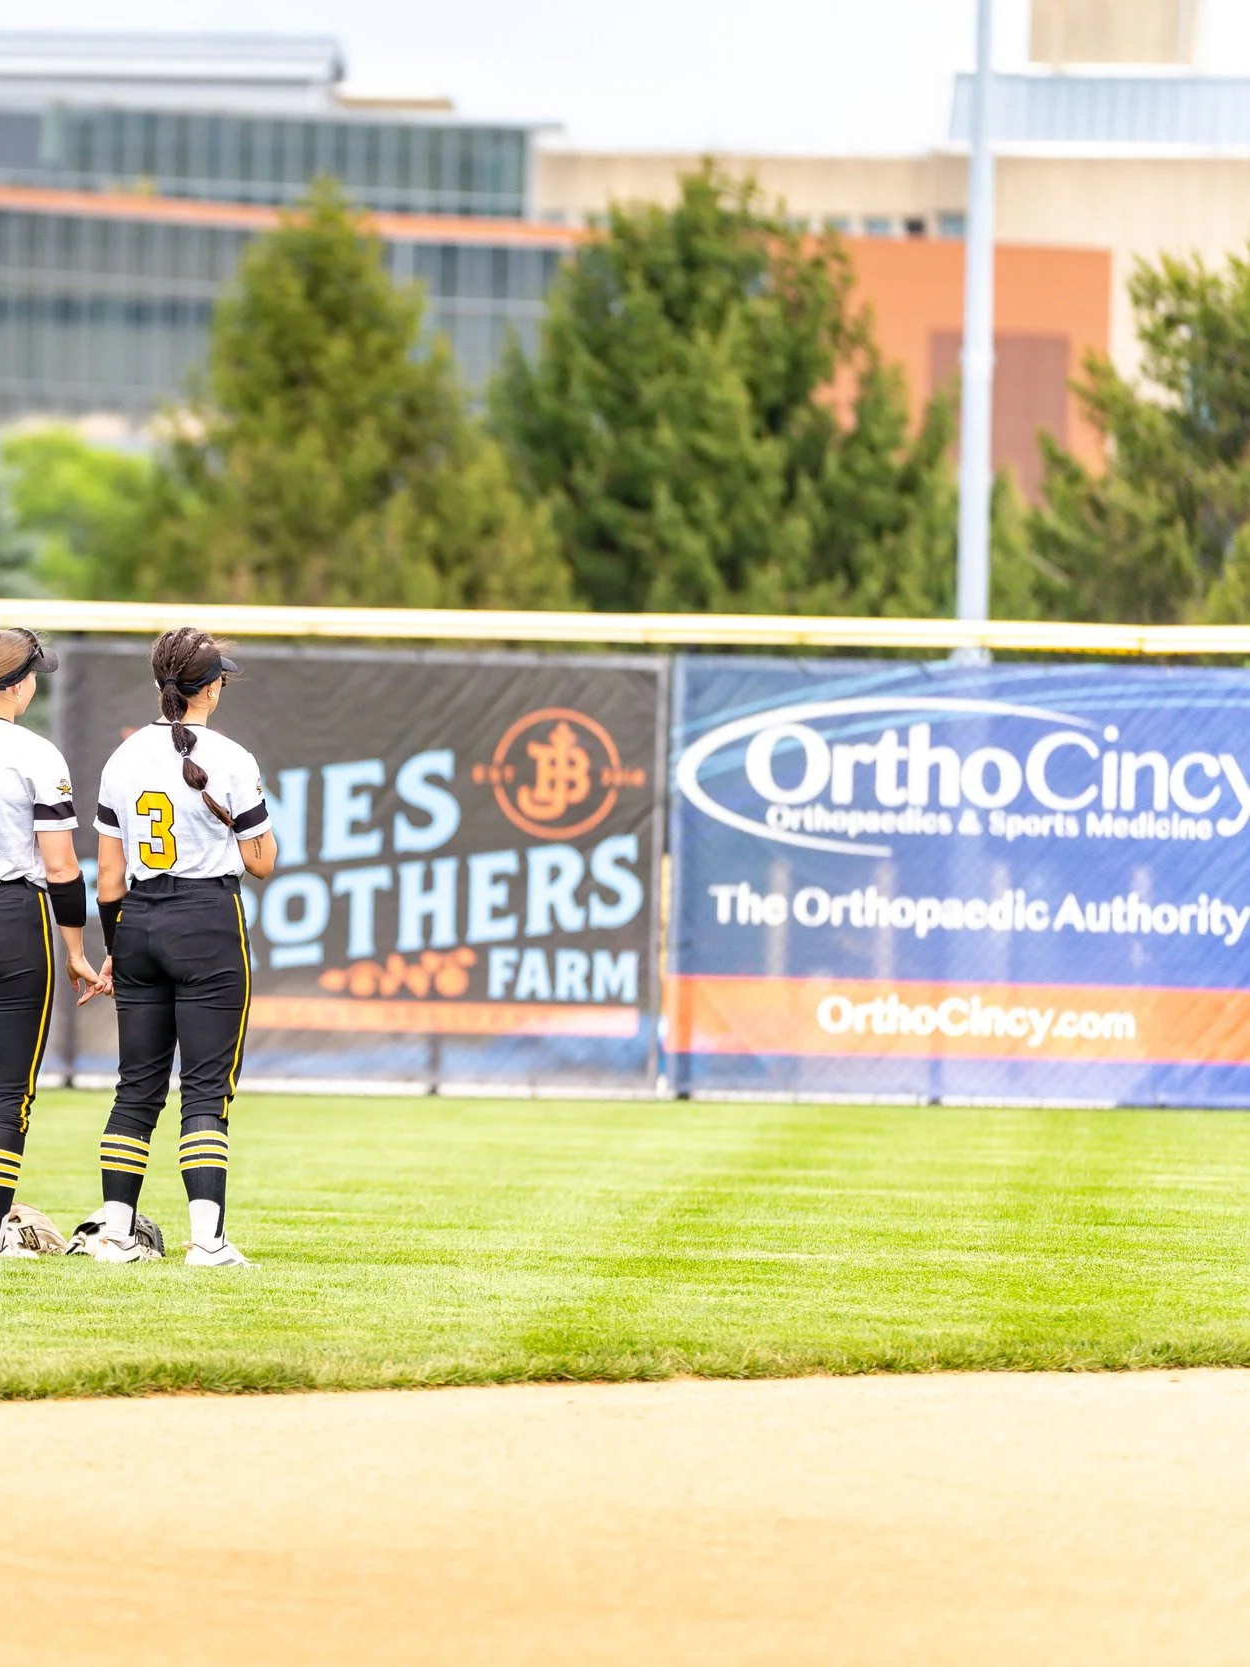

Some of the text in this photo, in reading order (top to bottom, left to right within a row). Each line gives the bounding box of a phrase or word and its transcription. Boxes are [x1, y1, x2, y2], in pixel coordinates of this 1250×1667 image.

[263, 750, 461, 869] NES
[745, 723, 1250, 838] OrthoCincy
[136, 790, 177, 869] 3
[766, 803, 953, 838] Orthopaedics
[988, 808, 1080, 841] Sports
[1086, 811, 1213, 841] Medicine
[240, 834, 643, 969] OTHERS
[709, 883, 1250, 946] The Orthopaedic Authority
[487, 947, 639, 1002] FARM
[817, 995, 1136, 1046] OrthoCincy.com
